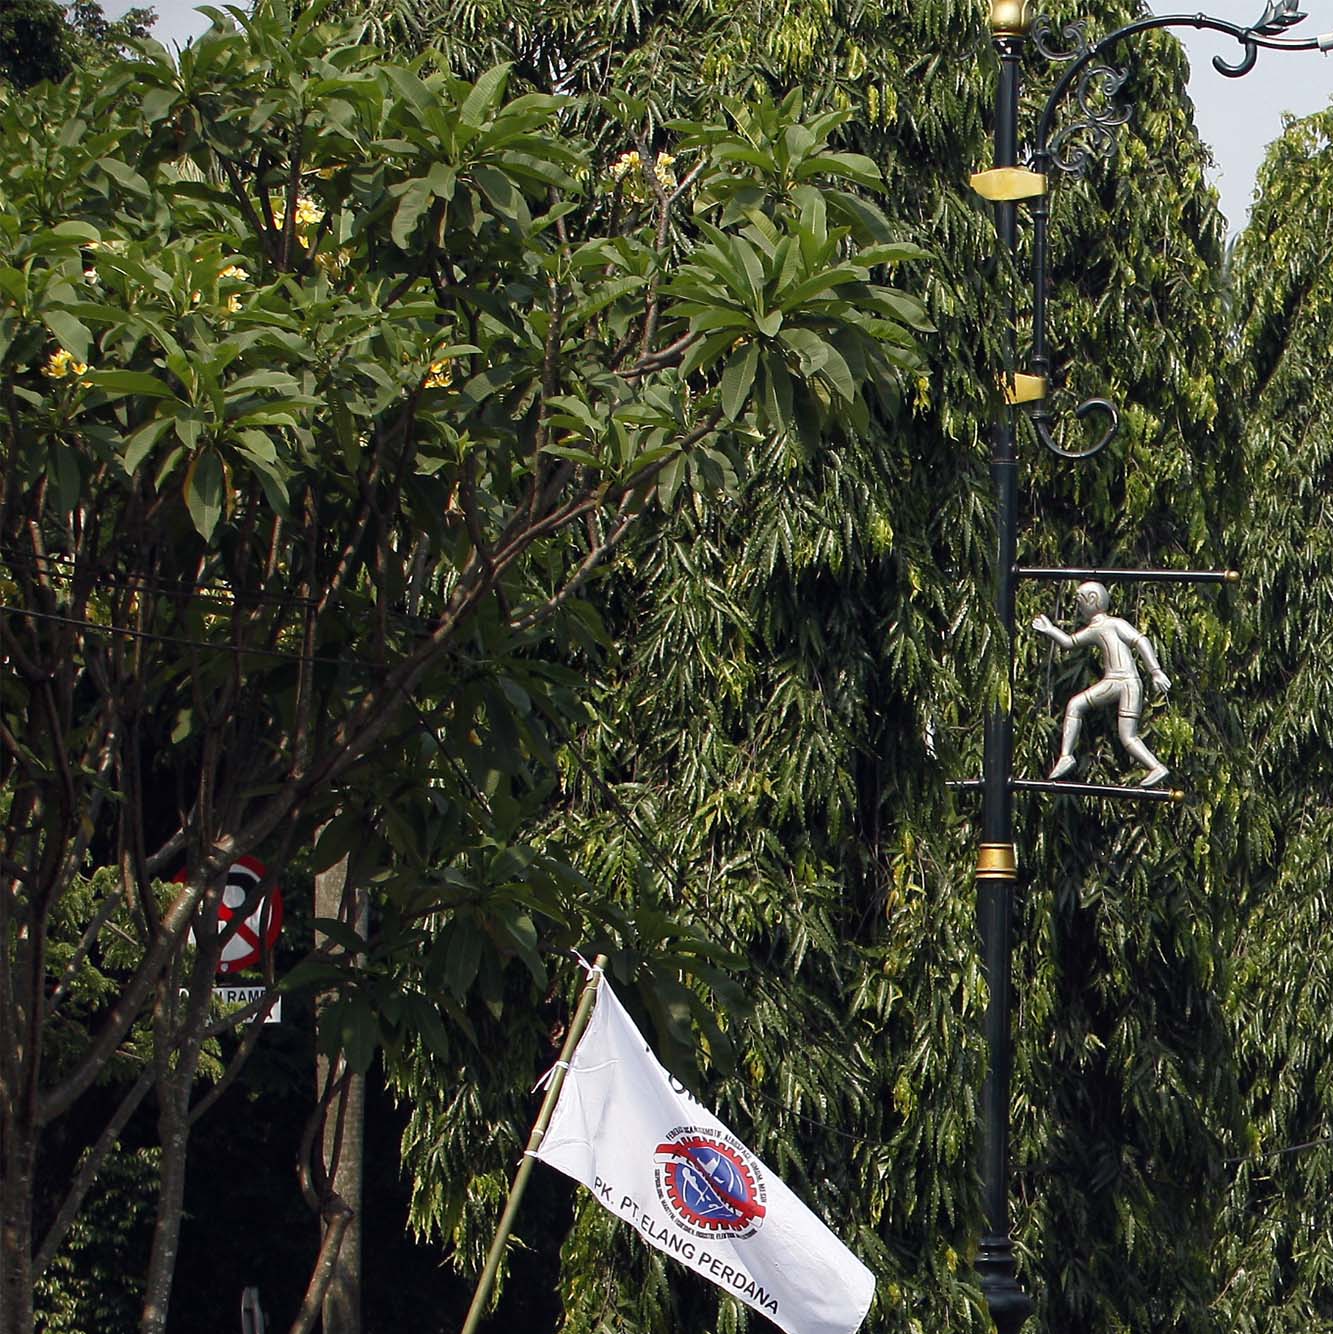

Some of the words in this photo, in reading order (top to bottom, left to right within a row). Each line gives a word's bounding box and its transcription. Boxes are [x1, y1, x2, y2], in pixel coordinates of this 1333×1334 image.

[594, 1176, 614, 1205] PK.
[620, 1196, 639, 1222] PT.
[641, 1216, 696, 1260] ELANG
[697, 1251, 779, 1315] PERDANA
